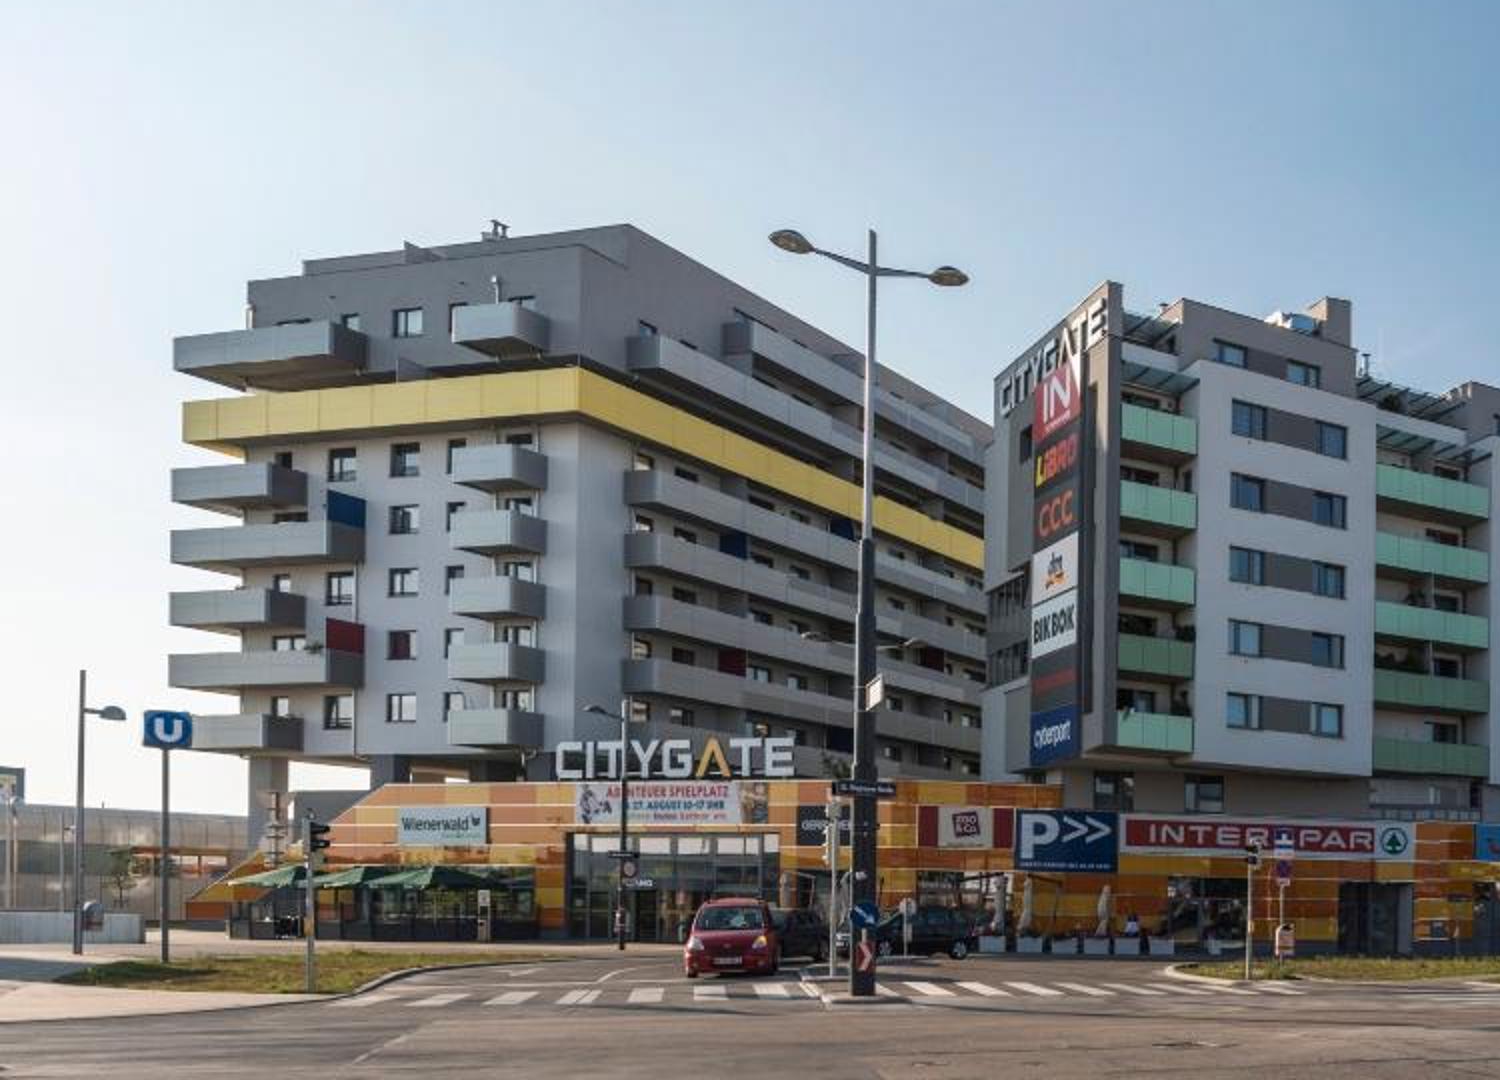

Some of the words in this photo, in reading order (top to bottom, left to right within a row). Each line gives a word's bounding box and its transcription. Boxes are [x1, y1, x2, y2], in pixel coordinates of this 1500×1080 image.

[1001, 296, 1107, 418] CITYGATE
[1040, 491, 1073, 537] CCC
[154, 717, 183, 743] U
[555, 736, 795, 779] CITYGATE
[607, 784, 666, 798] ABNTEUER
[401, 815, 469, 831] Wienerwald
[1021, 814, 1060, 858] P
[1149, 823, 1374, 850] INTERPAR
